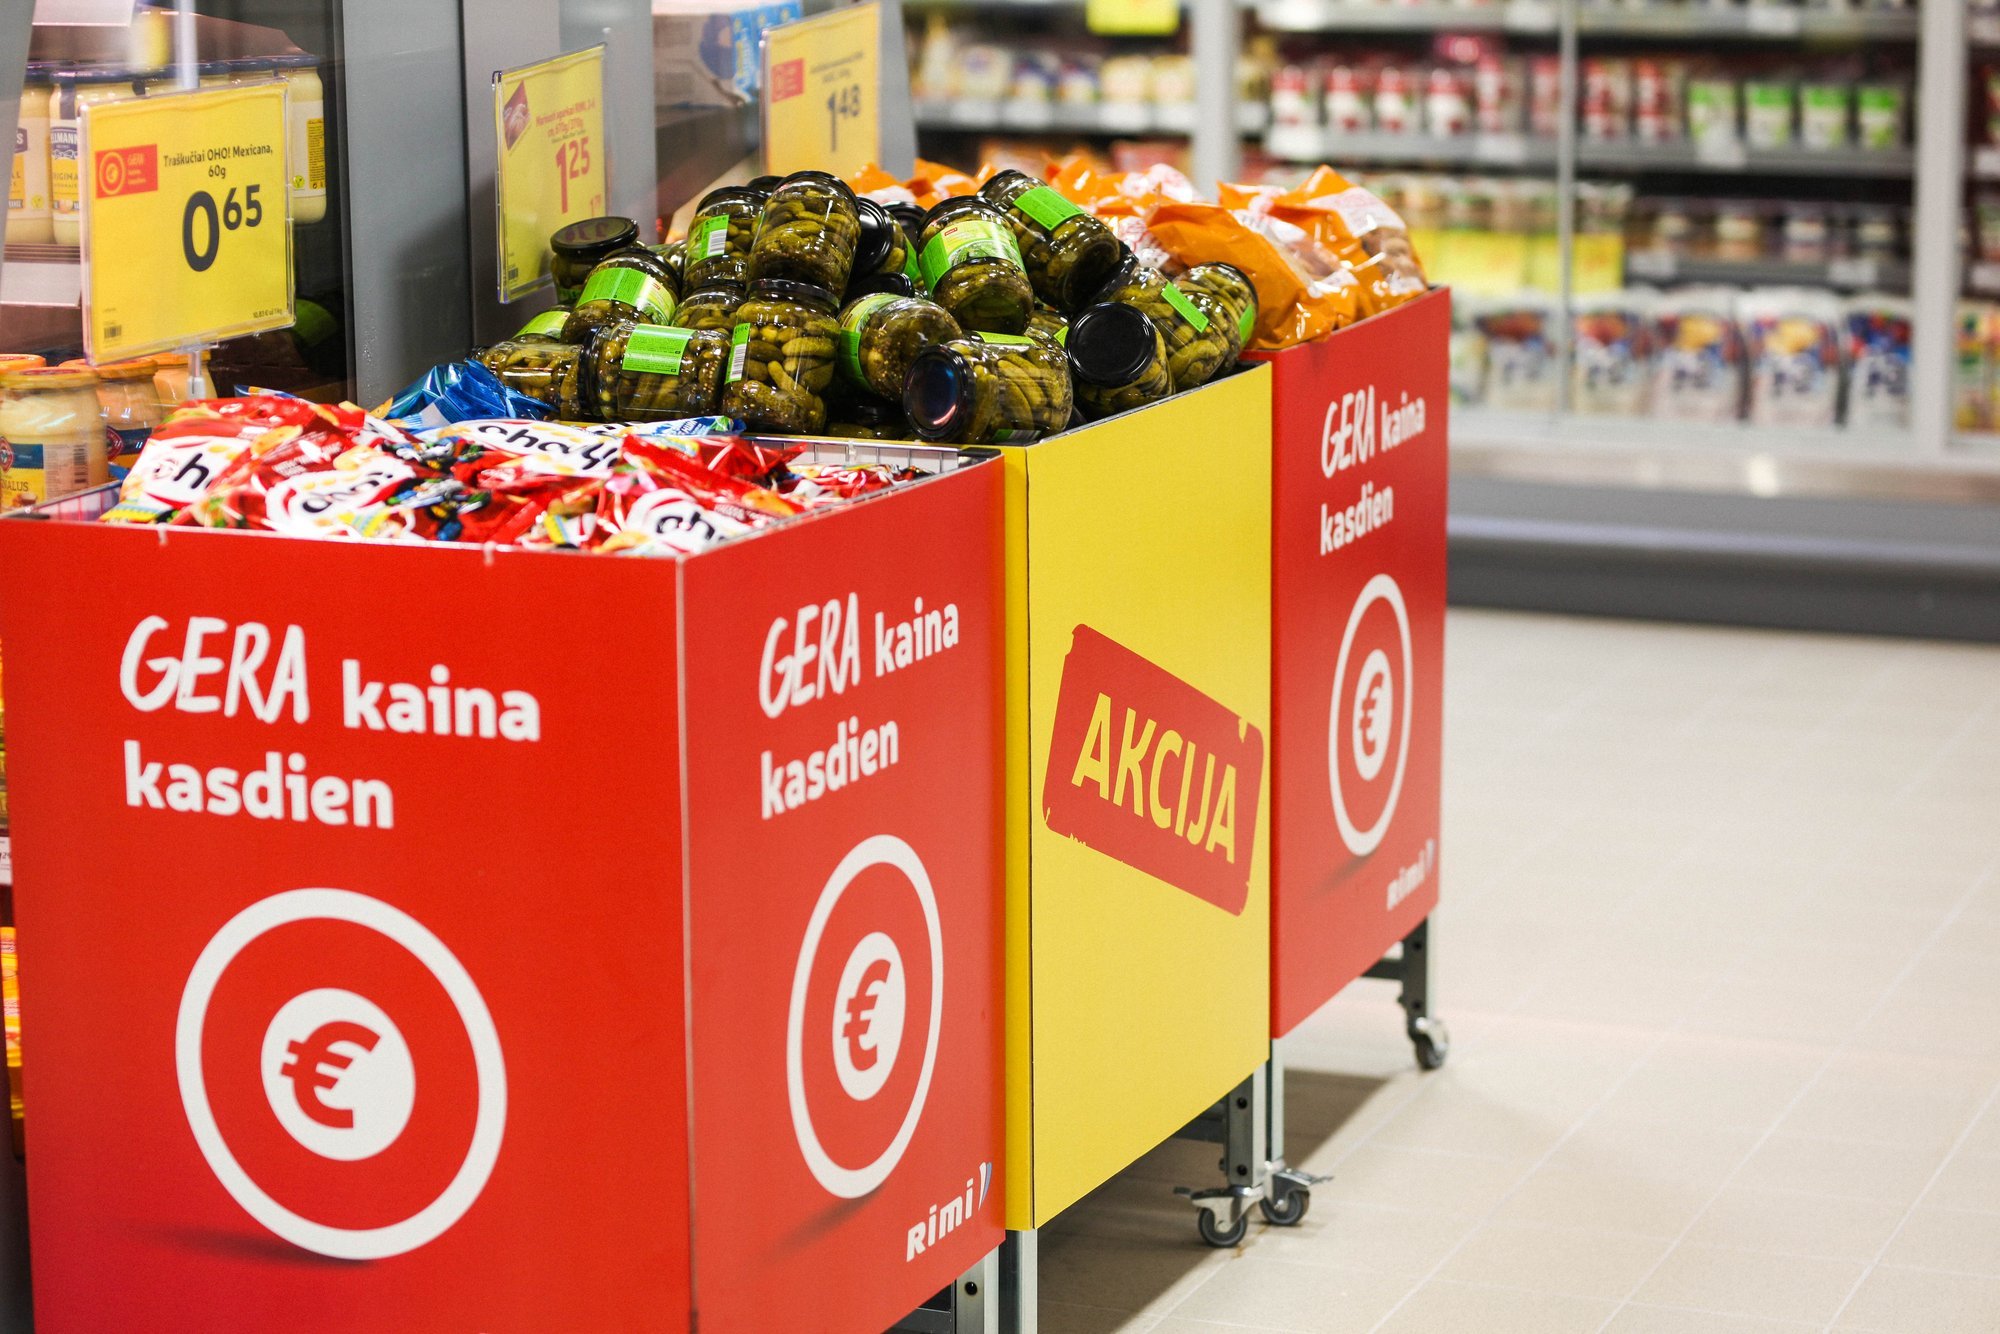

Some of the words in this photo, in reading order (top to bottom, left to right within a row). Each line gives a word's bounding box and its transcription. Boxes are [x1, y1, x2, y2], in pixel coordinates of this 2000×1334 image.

[163, 151, 205, 167] Traškučiai
[207, 146, 231, 161] OHO!
[232, 143, 273, 159] Mexicana,
[208, 164, 226, 179] 60g
[1321, 384, 1376, 479] GERA
[1381, 391, 1426, 452] kaina
[1320, 480, 1394, 556] kasdien
[119, 615, 310, 724] GERA
[341, 659, 541, 742] kaina
[759, 591, 861, 719] GERA
[874, 596, 959, 678] kaina
[123, 739, 395, 829] kasdien
[761, 715, 899, 821] kasdien
[1071, 691, 1237, 865] AKCIJA
